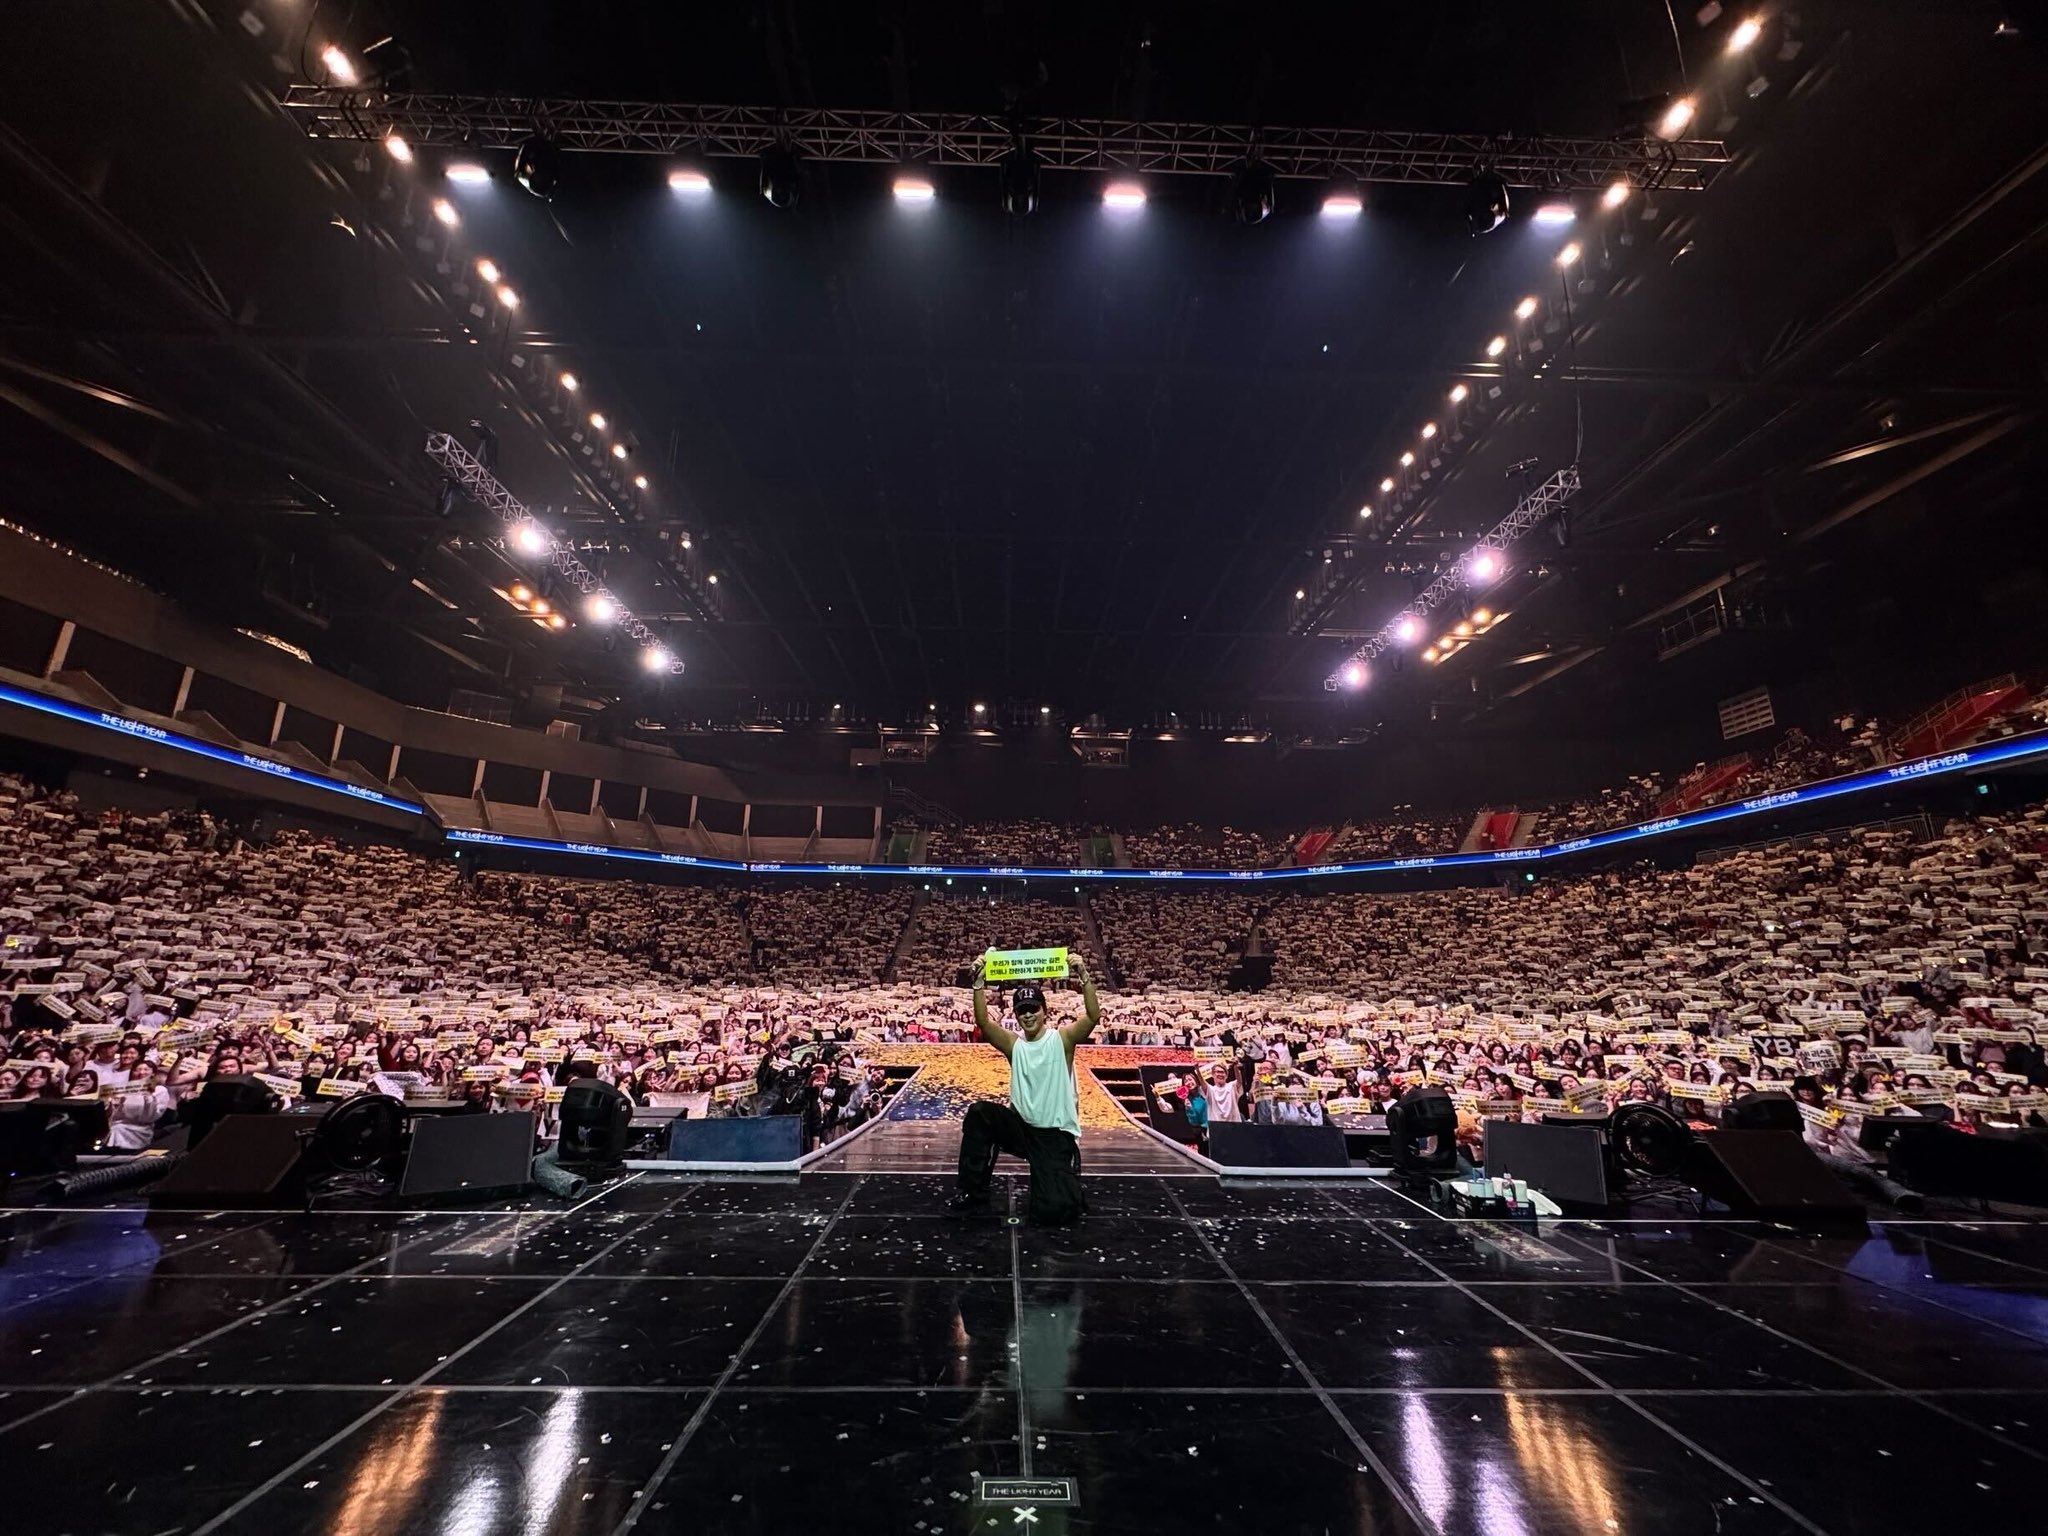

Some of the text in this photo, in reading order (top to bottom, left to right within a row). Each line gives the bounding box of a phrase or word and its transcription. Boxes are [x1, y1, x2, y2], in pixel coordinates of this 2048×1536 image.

[102, 714, 166, 738] THE LIGHT YEAR
[1888, 753, 1968, 777] THE LIGHT YEAR
